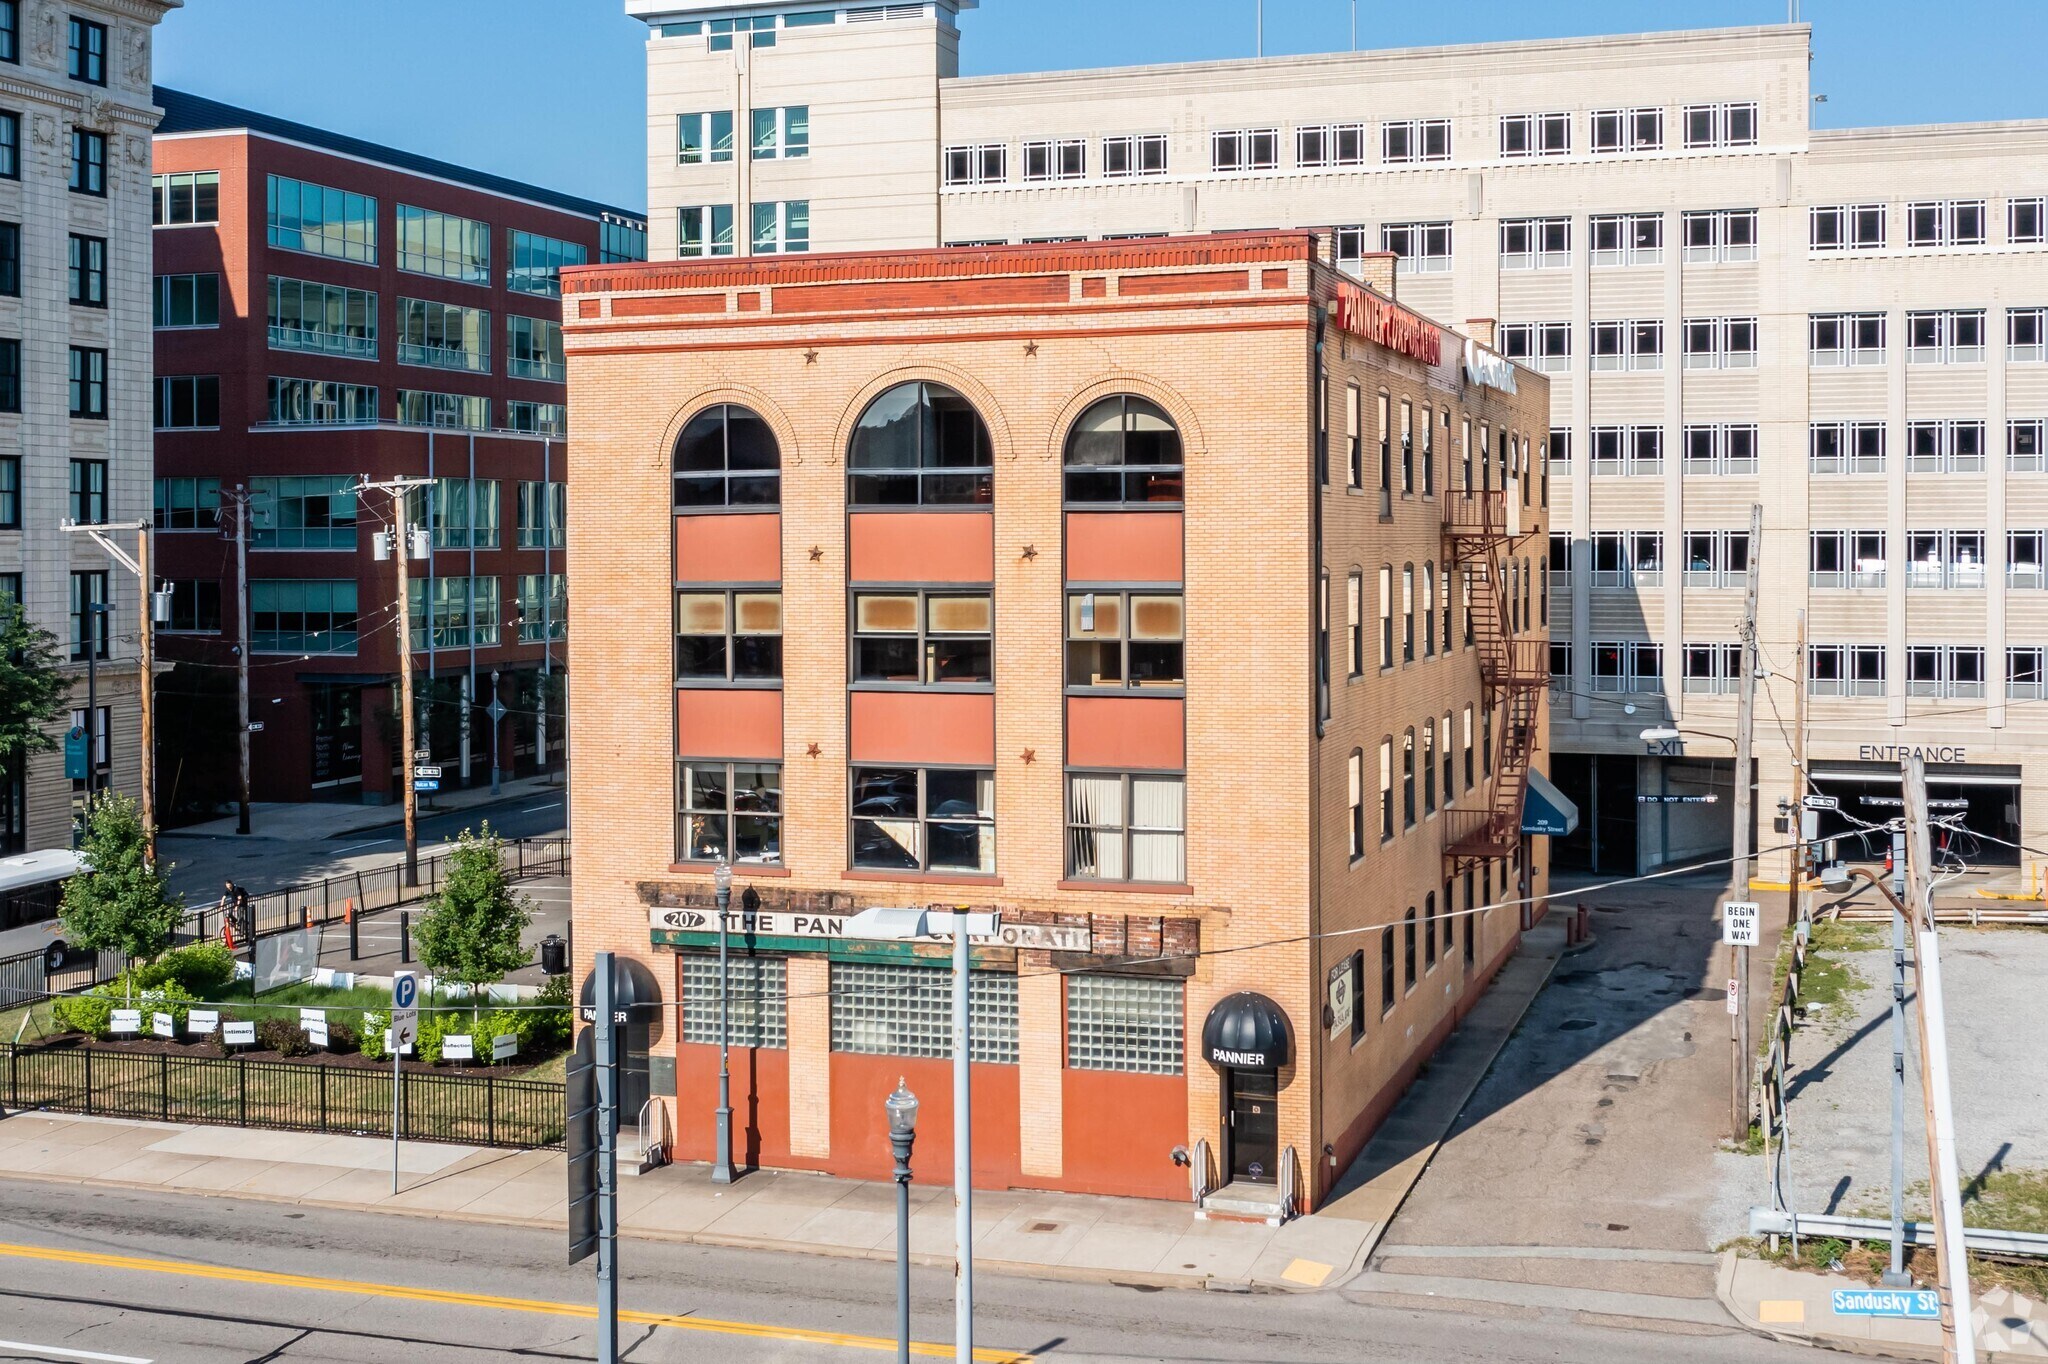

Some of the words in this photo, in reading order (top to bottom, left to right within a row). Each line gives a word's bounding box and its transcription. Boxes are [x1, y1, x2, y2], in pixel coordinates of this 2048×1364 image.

[1342, 284, 1385, 346] PANNIER
[1646, 740, 1688, 755] EXIT
[1859, 745, 1966, 763] ENTRANCE
[1728, 907, 1755, 916] BEGIN
[671, 911, 699, 927] 207
[727, 914, 773, 931] THE
[1732, 919, 1750, 928] ONE
[1731, 931, 1751, 940] WAY
[393, 1012, 405, 1022] Blue
[406, 1010, 416, 1019] Lots
[1213, 1048, 1264, 1065] PANNIER
[1834, 1291, 1911, 1314] Sandusky
[1917, 1292, 1936, 1311] St
